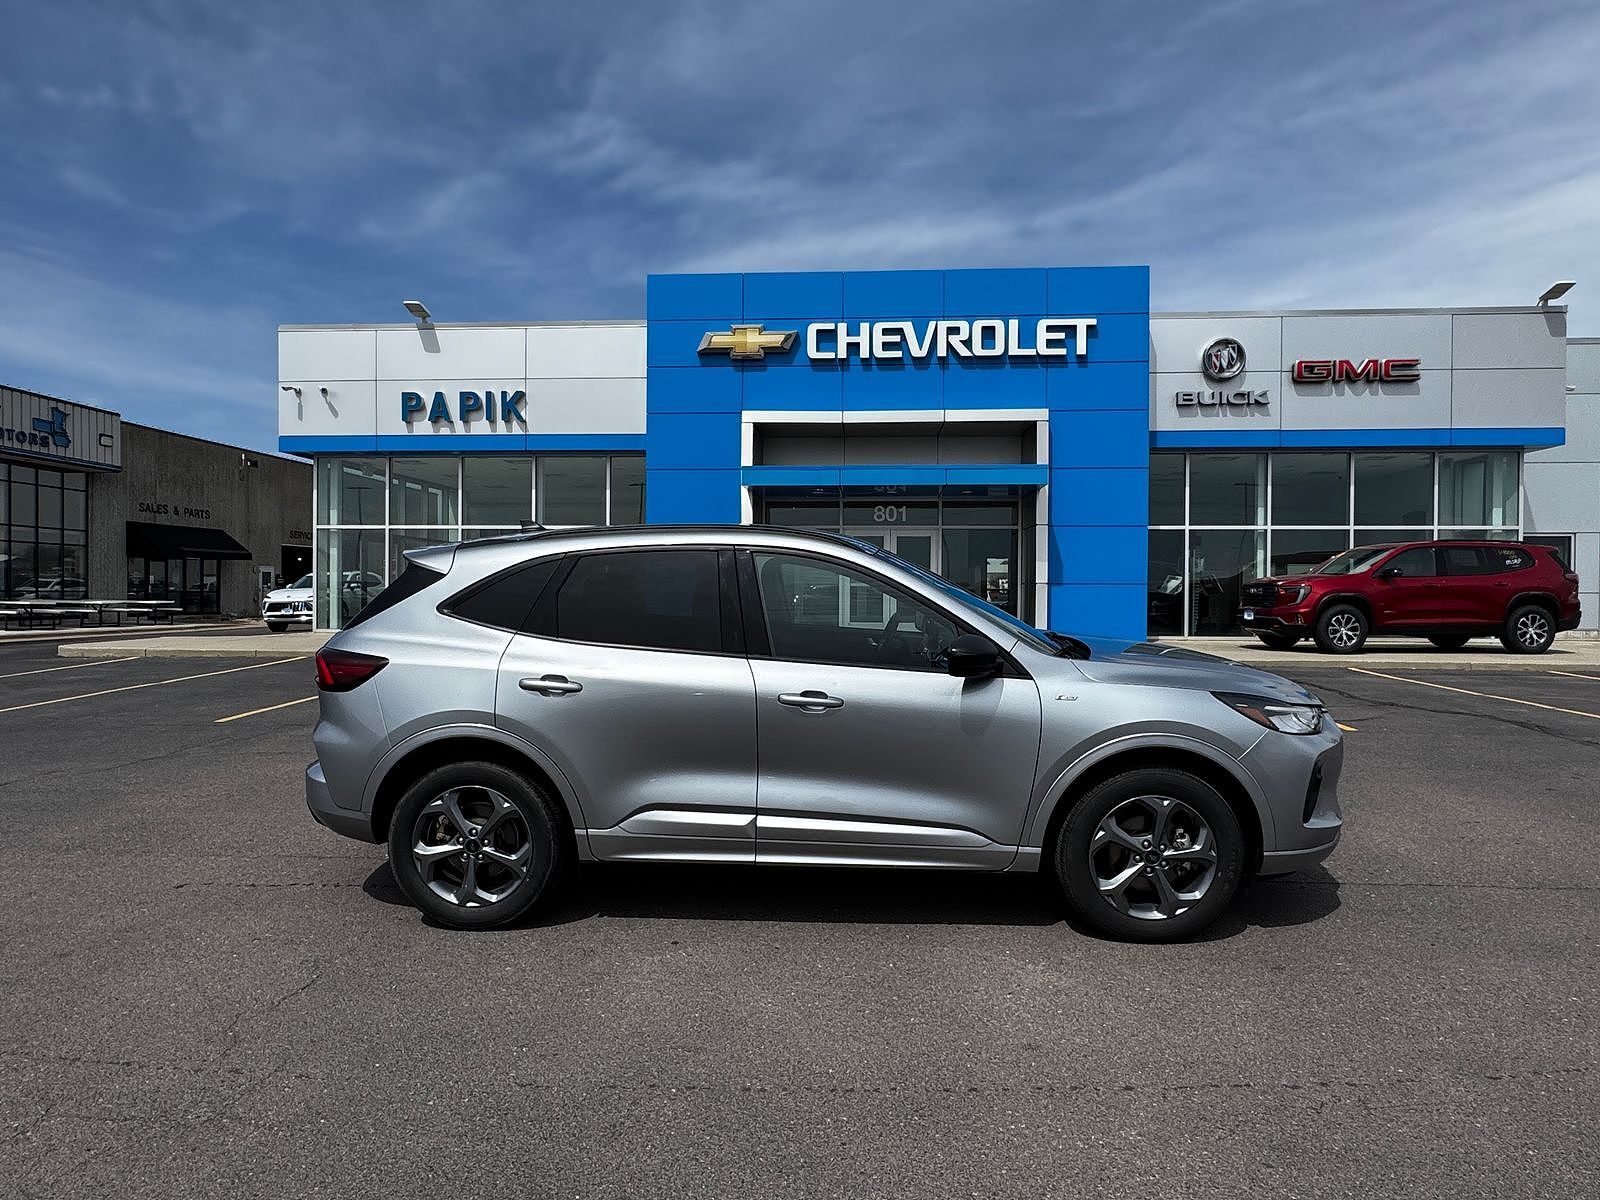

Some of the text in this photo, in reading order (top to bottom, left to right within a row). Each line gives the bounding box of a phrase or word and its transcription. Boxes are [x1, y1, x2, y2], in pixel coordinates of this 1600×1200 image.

[807, 318, 1097, 360] CHEVROLET
[1293, 358, 1421, 383] GMC
[402, 391, 526, 424] PAPIK
[1176, 389, 1270, 407] BUICK
[138, 502, 211, 519] SALES & PARTS
[873, 505, 907, 522] 801
